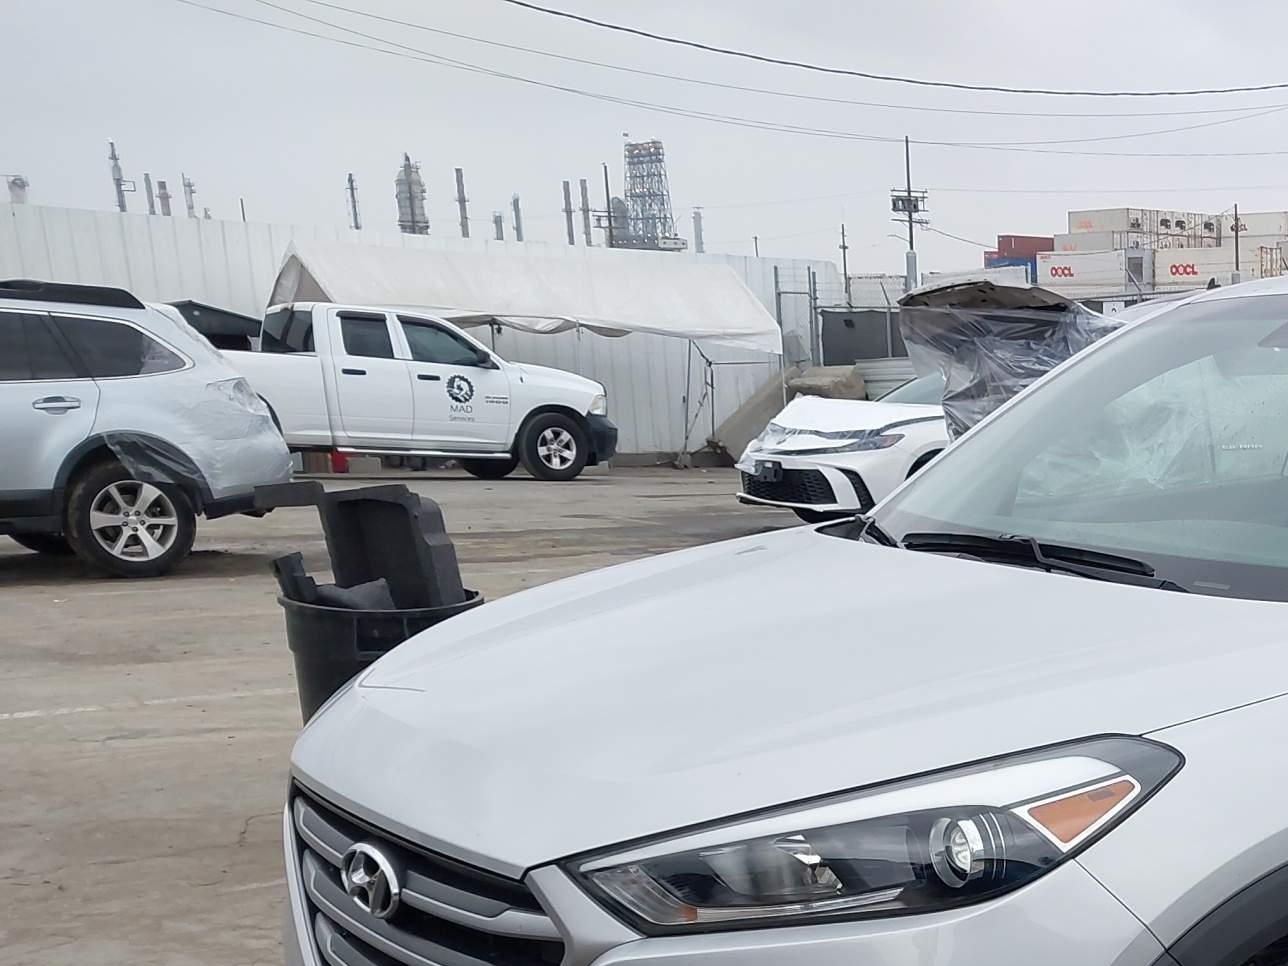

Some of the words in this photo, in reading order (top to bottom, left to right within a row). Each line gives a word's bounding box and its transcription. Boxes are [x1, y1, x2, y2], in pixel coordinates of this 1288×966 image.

[1050, 266, 1074, 278] OOCL
[1169, 264, 1199, 276] OOCL
[449, 405, 473, 414] MAD
